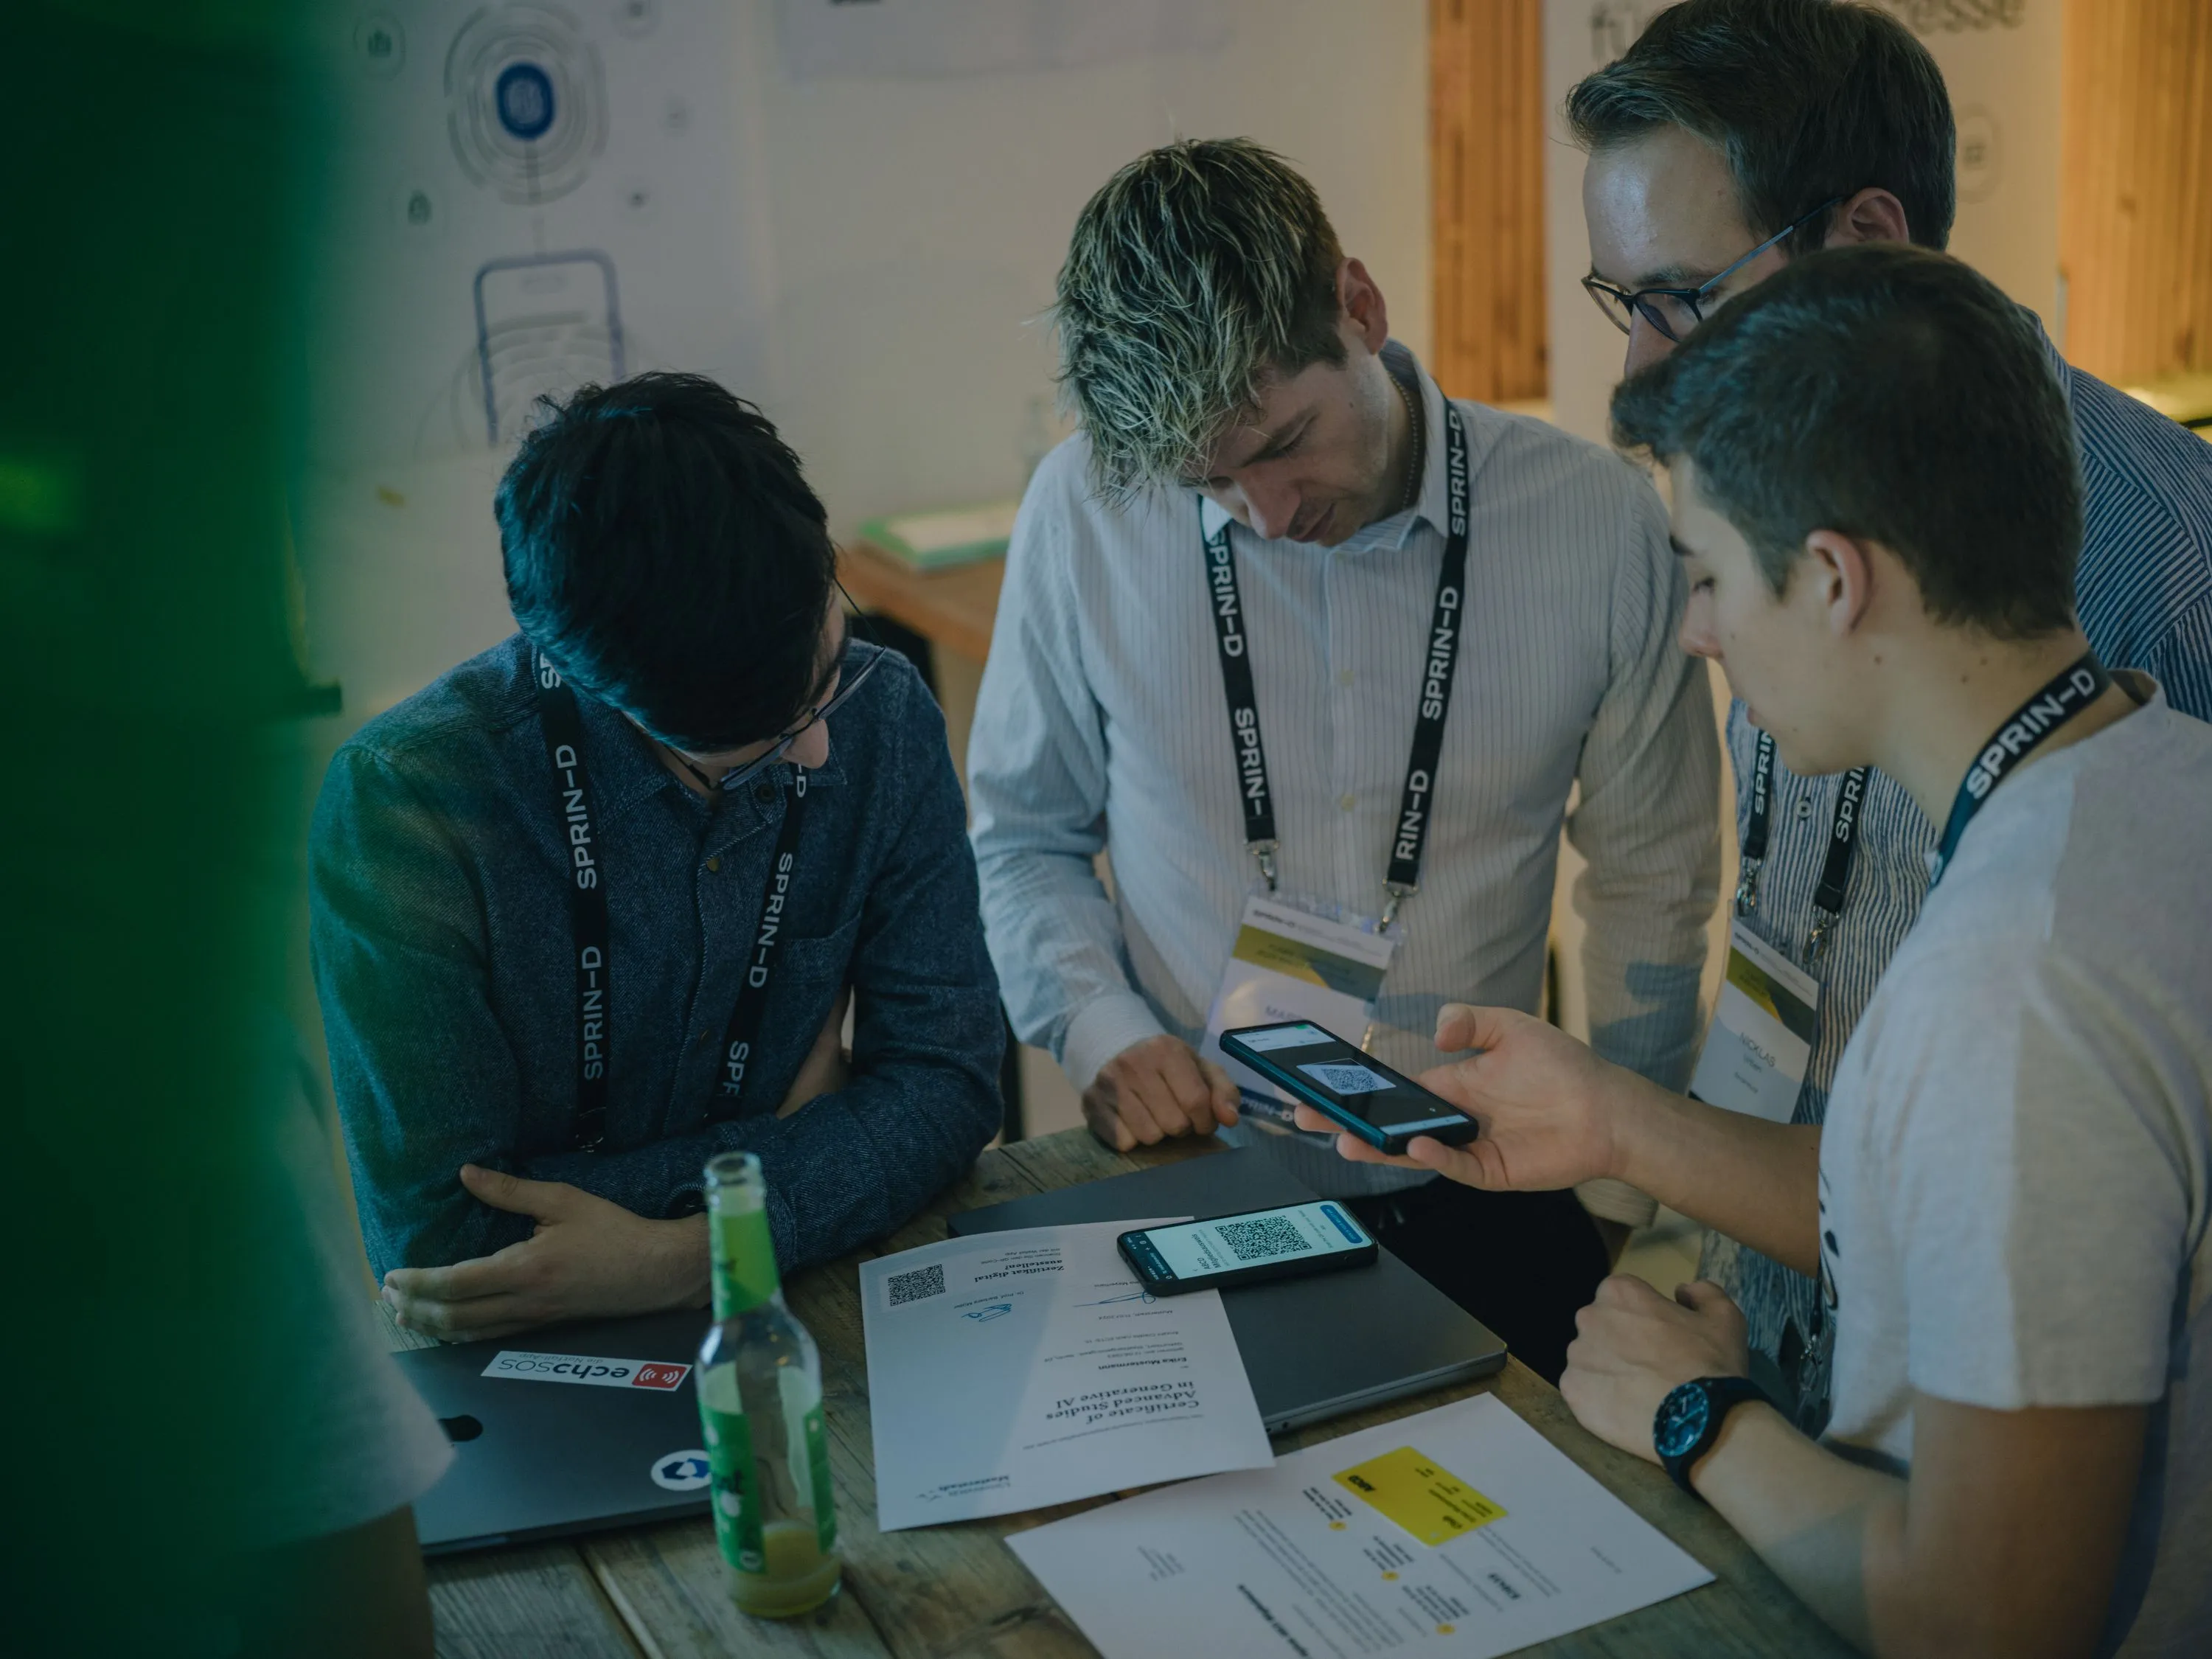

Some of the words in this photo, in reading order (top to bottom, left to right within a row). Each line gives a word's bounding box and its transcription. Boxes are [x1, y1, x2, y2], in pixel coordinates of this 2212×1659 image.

[1422, 586, 1459, 720] SPRIN-D
[1966, 669, 2096, 799] SPRIN-D
[1836, 767, 1865, 843] SPRI
[555, 745, 598, 889] SPRIN-D
[1396, 770, 1429, 860] RIN-D
[749, 852, 794, 989] SPRIN-D
[582, 945, 603, 1079] SPRIN-D
[1739, 1032, 1775, 1068] NICKLAS
[1005, 1259, 1062, 1270] ausstellen?
[1011, 1265, 1064, 1275] Zertifikat
[975, 1272, 1009, 1282] digital
[1080, 1383, 1173, 1402] Generative
[1178, 1381, 1194, 1390] in
[1056, 1397, 1075, 1410] AI
[1114, 1390, 1196, 1407] Advanced
[1046, 1402, 1109, 1420] Studies
[1109, 1400, 1200, 1417] Certificate
[1086, 1413, 1103, 1425] of
